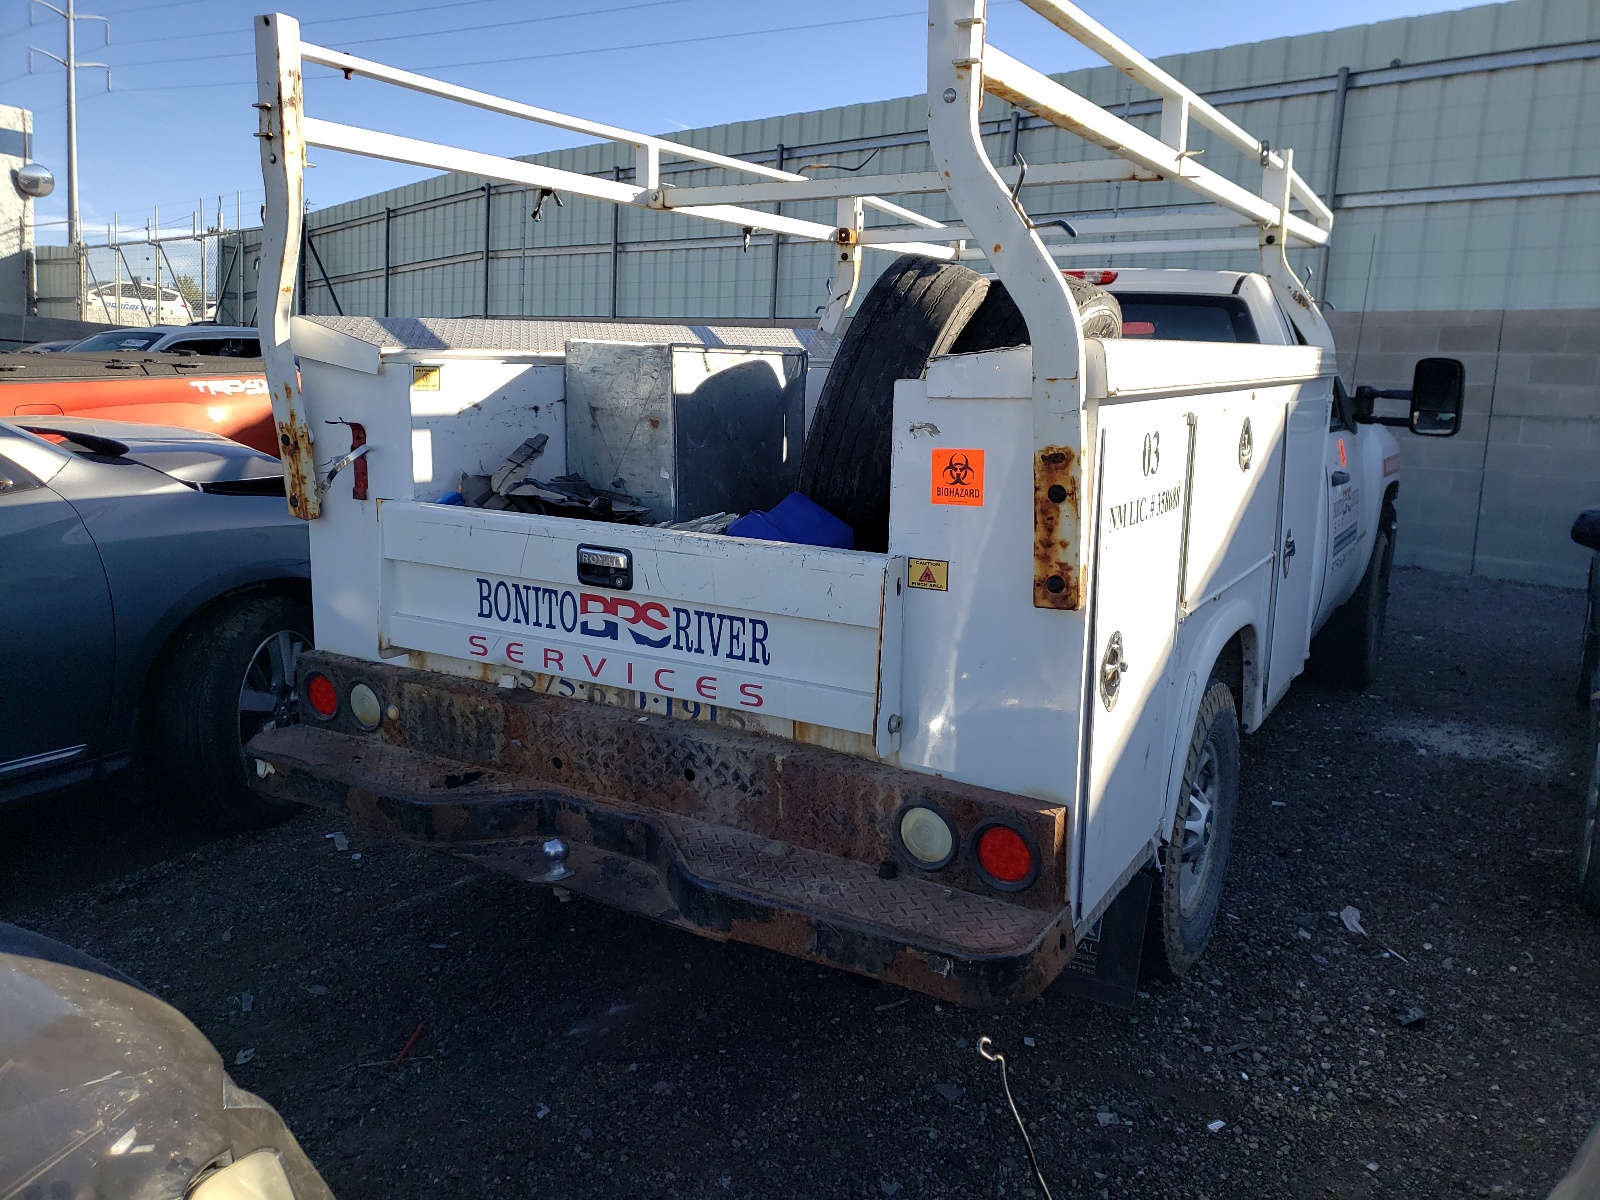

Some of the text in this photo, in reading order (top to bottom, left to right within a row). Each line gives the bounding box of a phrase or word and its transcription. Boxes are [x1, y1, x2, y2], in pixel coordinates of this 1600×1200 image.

[1142, 430, 1160, 477] 03
[936, 486, 980, 499] BIOHAZARD
[477, 577, 578, 633] BONITO
[672, 606, 771, 666] RIVER
[468, 634, 764, 708] SERVICES
